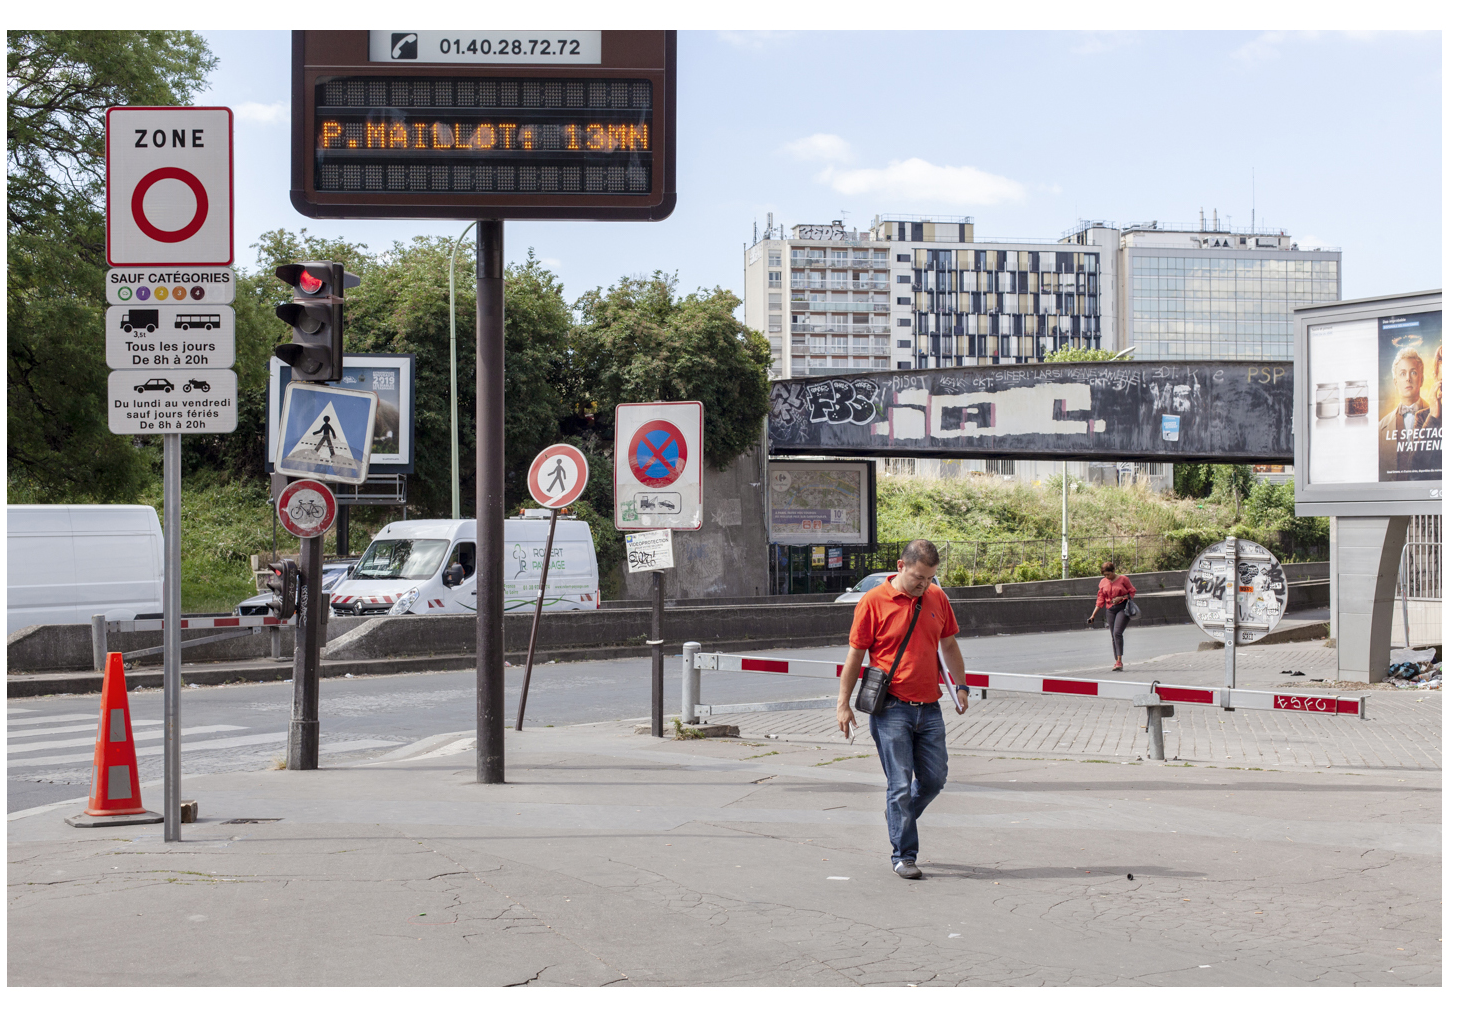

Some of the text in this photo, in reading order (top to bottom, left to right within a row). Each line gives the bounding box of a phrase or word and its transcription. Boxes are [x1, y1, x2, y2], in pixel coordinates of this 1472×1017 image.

[439, 39, 581, 56] 01.40.28.72.72
[134, 129, 204, 148] ZONE
[322, 121, 533, 149] P.MAILLOT:
[111, 271, 230, 283] SAUF CATÉGORIES
[133, 331, 146, 339] 3,5t
[125, 341, 215, 353] Tous les jours
[133, 354, 208, 365] De 8h à 20h
[372, 376, 395, 384] 2019
[1247, 367, 1285, 385] PSP
[114, 400, 129, 408] Du
[133, 399, 161, 408] lundi
[182, 398, 231, 407] vendredi
[126, 409, 219, 420] sauf jours fériés
[140, 420, 206, 429] De 8h à 20h
[1385, 429, 1397, 441] LE
[533, 548, 563, 558] ROERT
